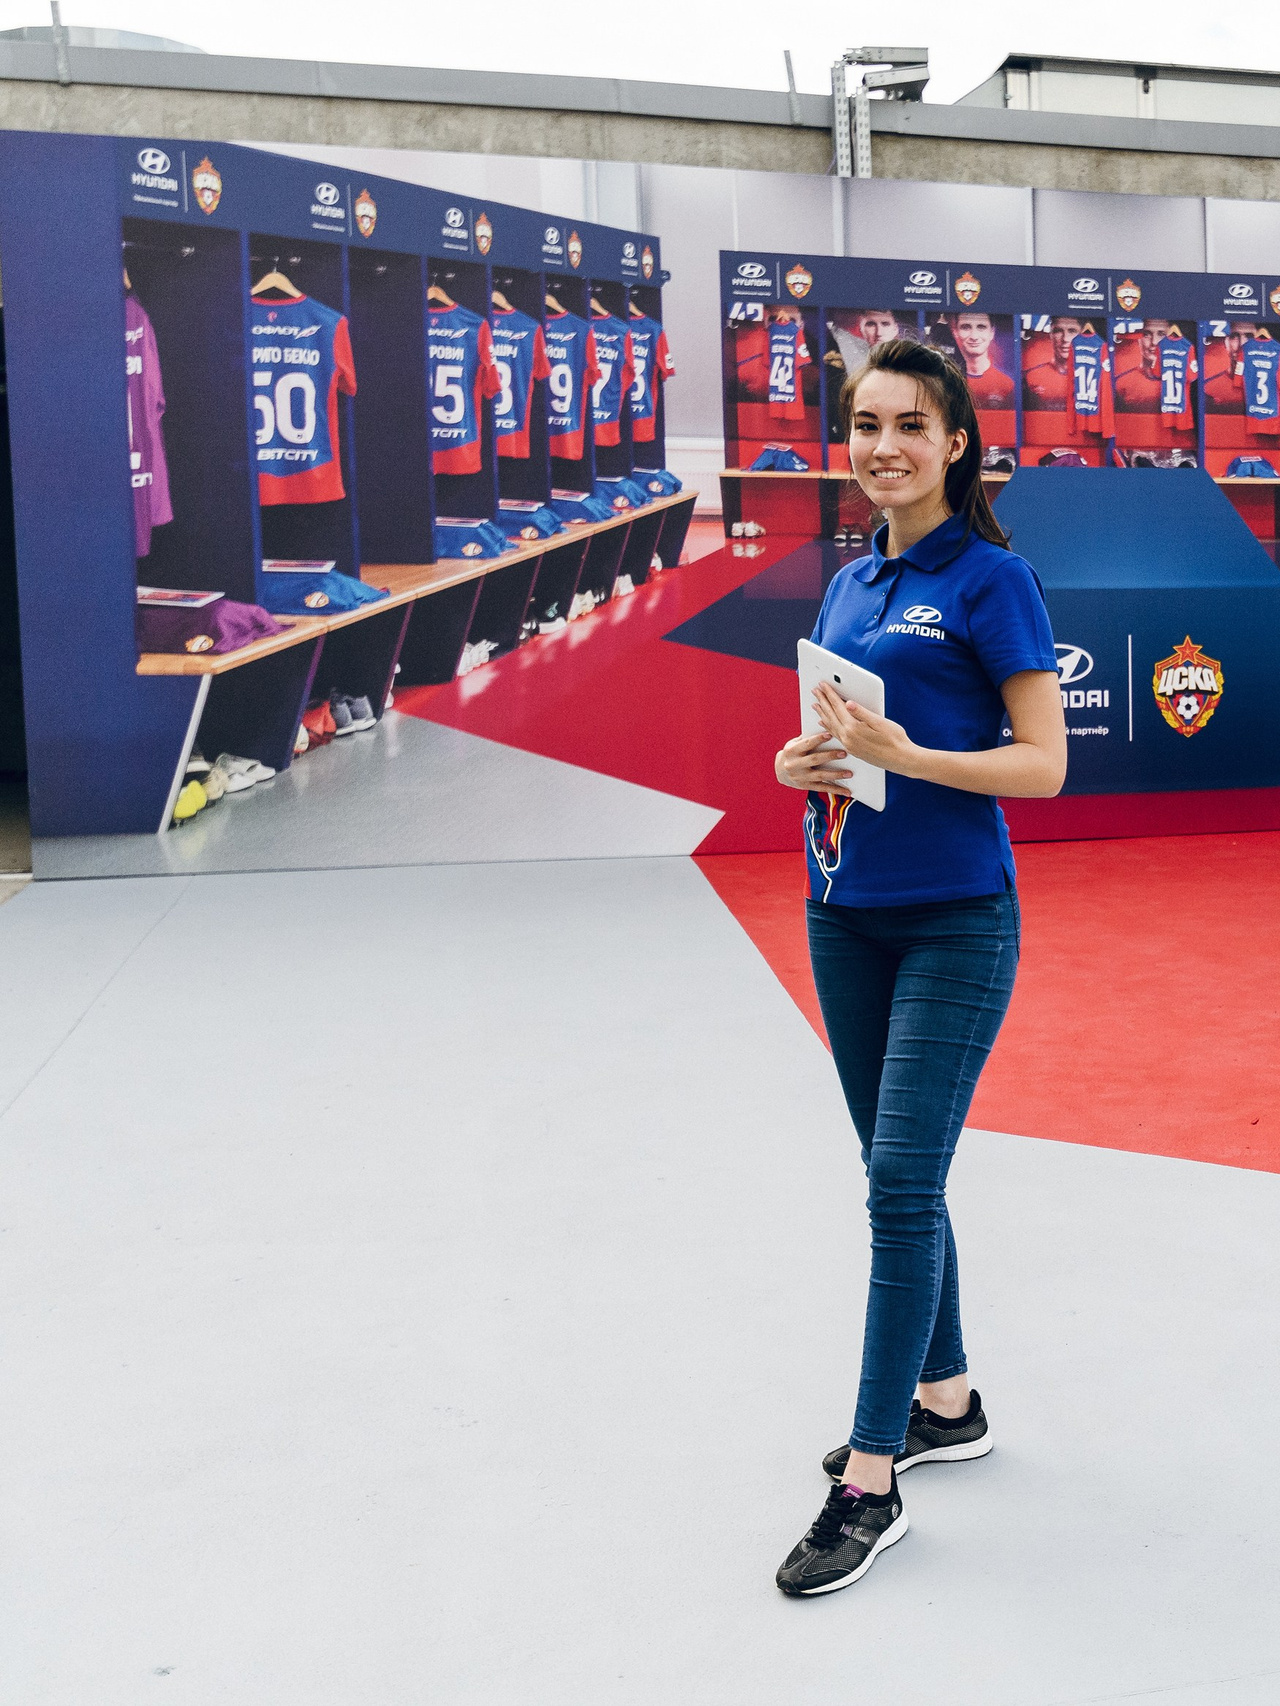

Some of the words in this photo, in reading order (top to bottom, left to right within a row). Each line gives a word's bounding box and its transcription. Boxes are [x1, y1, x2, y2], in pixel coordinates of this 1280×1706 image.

[132, 172, 178, 192] HYUNDAI
[310, 203, 345, 219] HYUNDAI
[732, 278, 772, 287] HYUNDAI
[904, 286, 942, 295] HYUNDAI
[1068, 292, 1104, 301] HYUNDAI
[252, 346, 282, 364] РИГО
[769, 355, 794, 393] 42
[549, 363, 573, 413] 9
[1074, 366, 1098, 402] 14
[1256, 371, 1268, 405] 3
[432, 365, 465, 424] 5
[253, 371, 316, 445] 50
[431, 427, 468, 439] TCITY
[886, 623, 945, 641] HYUNDAI
[1157, 666, 1219, 694] ЦСКА
[1060, 690, 1109, 708] NDAI
[1071, 726, 1109, 737] партнёр
